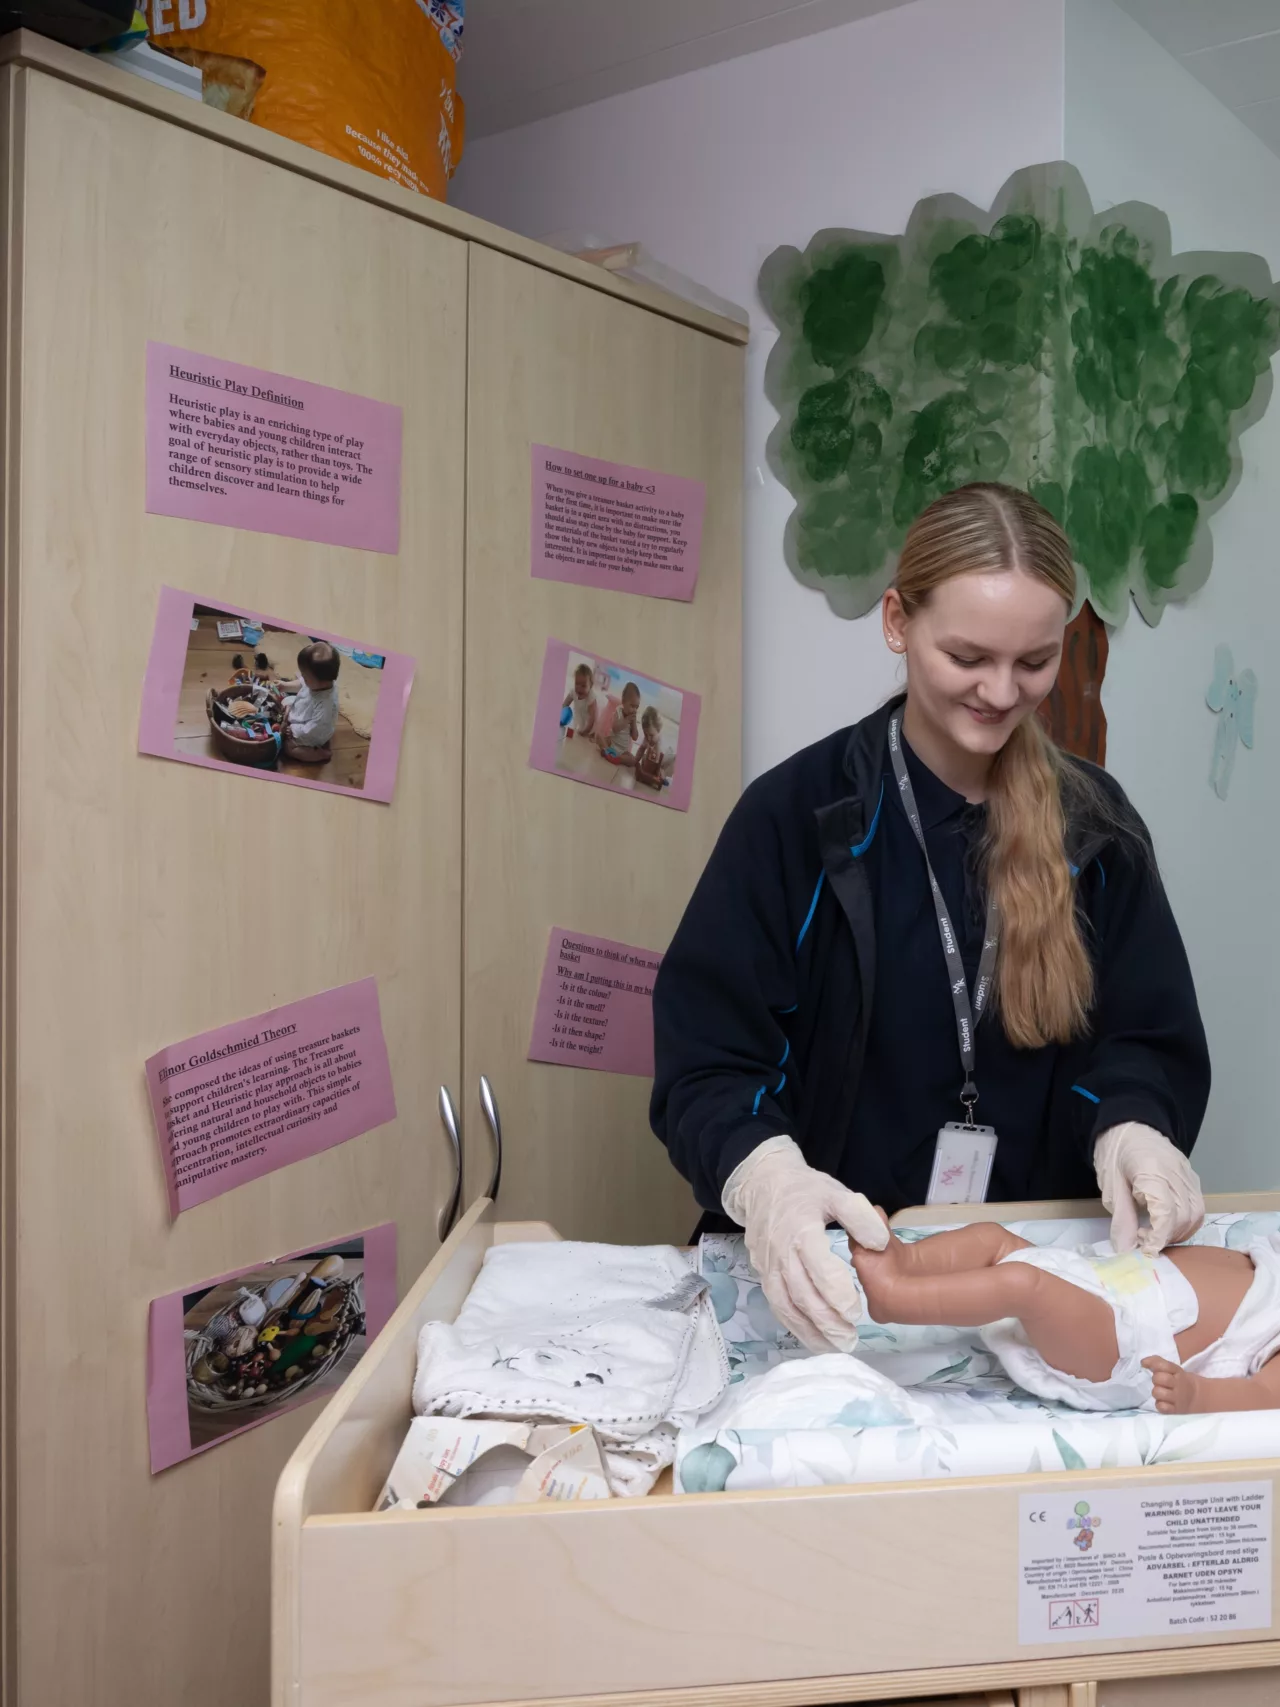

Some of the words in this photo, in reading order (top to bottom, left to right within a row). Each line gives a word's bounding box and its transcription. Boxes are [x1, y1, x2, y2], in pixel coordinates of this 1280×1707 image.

[346, 124, 381, 152] Because
[384, 147, 400, 166] they
[170, 364, 221, 388] Heuristic
[224, 378, 248, 398] Play
[251, 385, 304, 409] Definition
[169, 393, 217, 413] Heuristic
[219, 406, 240, 422] play
[243, 412, 251, 421] is
[254, 415, 266, 424] an
[268, 419, 311, 438] enriching
[312, 428, 332, 442] type
[333, 432, 345, 443] of
[346, 435, 364, 450] play
[169, 409, 201, 424] where
[203, 415, 236, 432] babies
[238, 426, 256, 436] and
[258, 430, 288, 446] young
[289, 436, 326, 452] children
[328, 444, 361, 460] interact
[168, 438, 190, 449] goal
[194, 442, 204, 452] of
[208, 444, 251, 462] heuristic
[254, 454, 274, 469] play
[276, 459, 284, 469] is
[286, 461, 296, 471] to
[298, 465, 332, 478] provide
[333, 472, 339, 480] a
[341, 473, 362, 485] wide
[169, 424, 193, 436] with
[196, 430, 240, 449] everyday
[242, 438, 279, 457] objects,
[281, 448, 309, 461] rather
[310, 453, 331, 466] than
[332, 458, 353, 472] toys.
[356, 462, 373, 475] The
[169, 452, 198, 465] range
[200, 456, 211, 466] of
[214, 461, 252, 477] sensory
[254, 468, 308, 486] stimulation
[309, 478, 319, 488] to
[320, 479, 340, 495] help
[169, 463, 211, 480] children
[214, 471, 255, 488] discover
[257, 482, 275, 492] and
[276, 483, 300, 497] learn
[302, 489, 330, 505] things
[332, 494, 345, 506] for
[169, 476, 227, 495] themselves.
[559, 950, 581, 963] basket
[940, 918, 954, 954] Student
[975, 976, 990, 1010] Student
[188, 1033, 260, 1070] Goldschmied
[261, 1024, 297, 1043] Theory
[960, 1018, 970, 1052] Student
[170, 1094, 205, 1114] support
[206, 1078, 251, 1101] children's
[252, 1066, 291, 1085] learning.
[292, 1057, 308, 1070] The
[310, 1044, 344, 1063] Treasure
[174, 1074, 220, 1100] composed
[222, 1070, 237, 1083] the
[238, 1063, 261, 1077] ideas
[263, 1055, 273, 1068] of
[274, 1049, 298, 1064] using
[298, 1038, 330, 1055] treasure
[331, 1026, 361, 1043] baskets
[193, 1105, 210, 1120] and
[212, 1092, 253, 1113] Heuristic
[255, 1084, 274, 1100] play
[275, 1066, 313, 1091] approach
[314, 1065, 321, 1074] is
[322, 1058, 333, 1071] all
[334, 1050, 356, 1067] about
[1144, 1509, 1182, 1518] WARNING:
[1214, 1505, 1238, 1513] LEAVE
[1166, 1519, 1188, 1527] CHILD
[1190, 1515, 1240, 1525] UNATTENDED
[1146, 1562, 1186, 1571] ADVARSEL
[1192, 1558, 1230, 1568] EFTERLAD
[1232, 1556, 1259, 1565] ALDRIG
[1163, 1571, 1193, 1580] BARNET
[1195, 1570, 1216, 1578] UDEN
[1218, 1568, 1242, 1576] OPSYN
